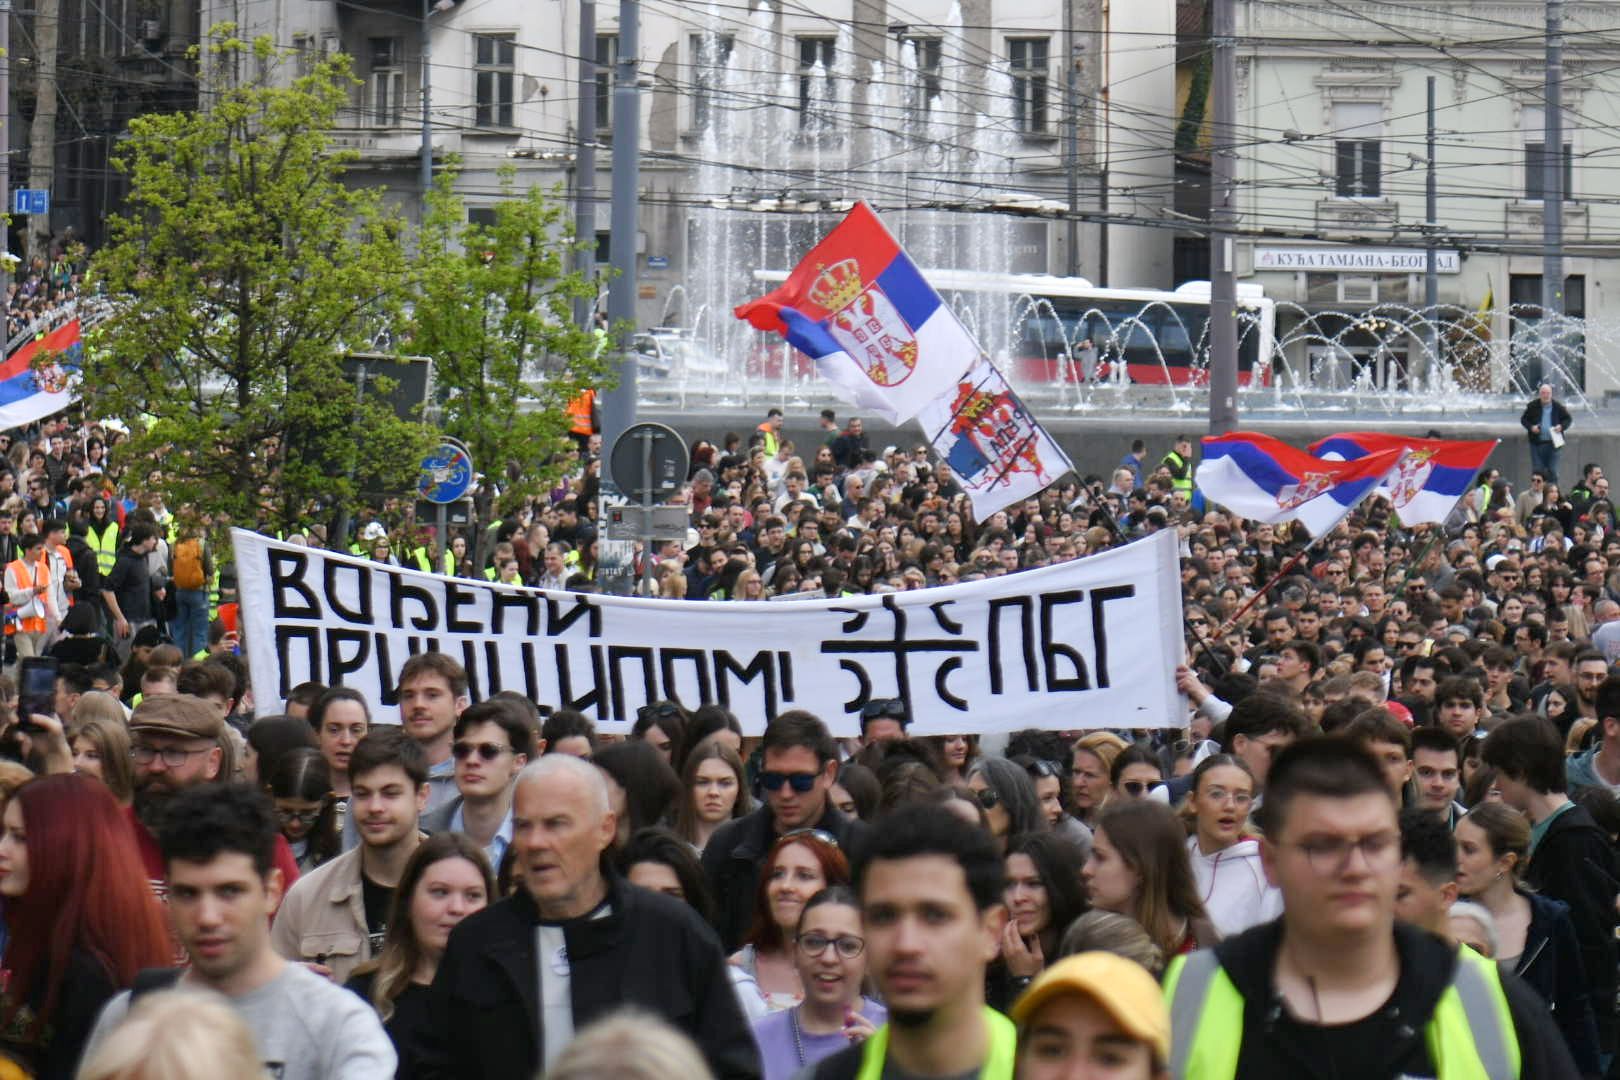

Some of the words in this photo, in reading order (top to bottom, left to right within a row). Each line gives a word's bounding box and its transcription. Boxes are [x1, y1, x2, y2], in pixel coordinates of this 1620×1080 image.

[1277, 253, 1318, 266] КУЋА
[1319, 254, 1454, 269] ТАМЈАНА-БЕОГАД
[268, 548, 602, 637] ВОЂЕНИ
[988, 584, 1135, 694] ПБГ
